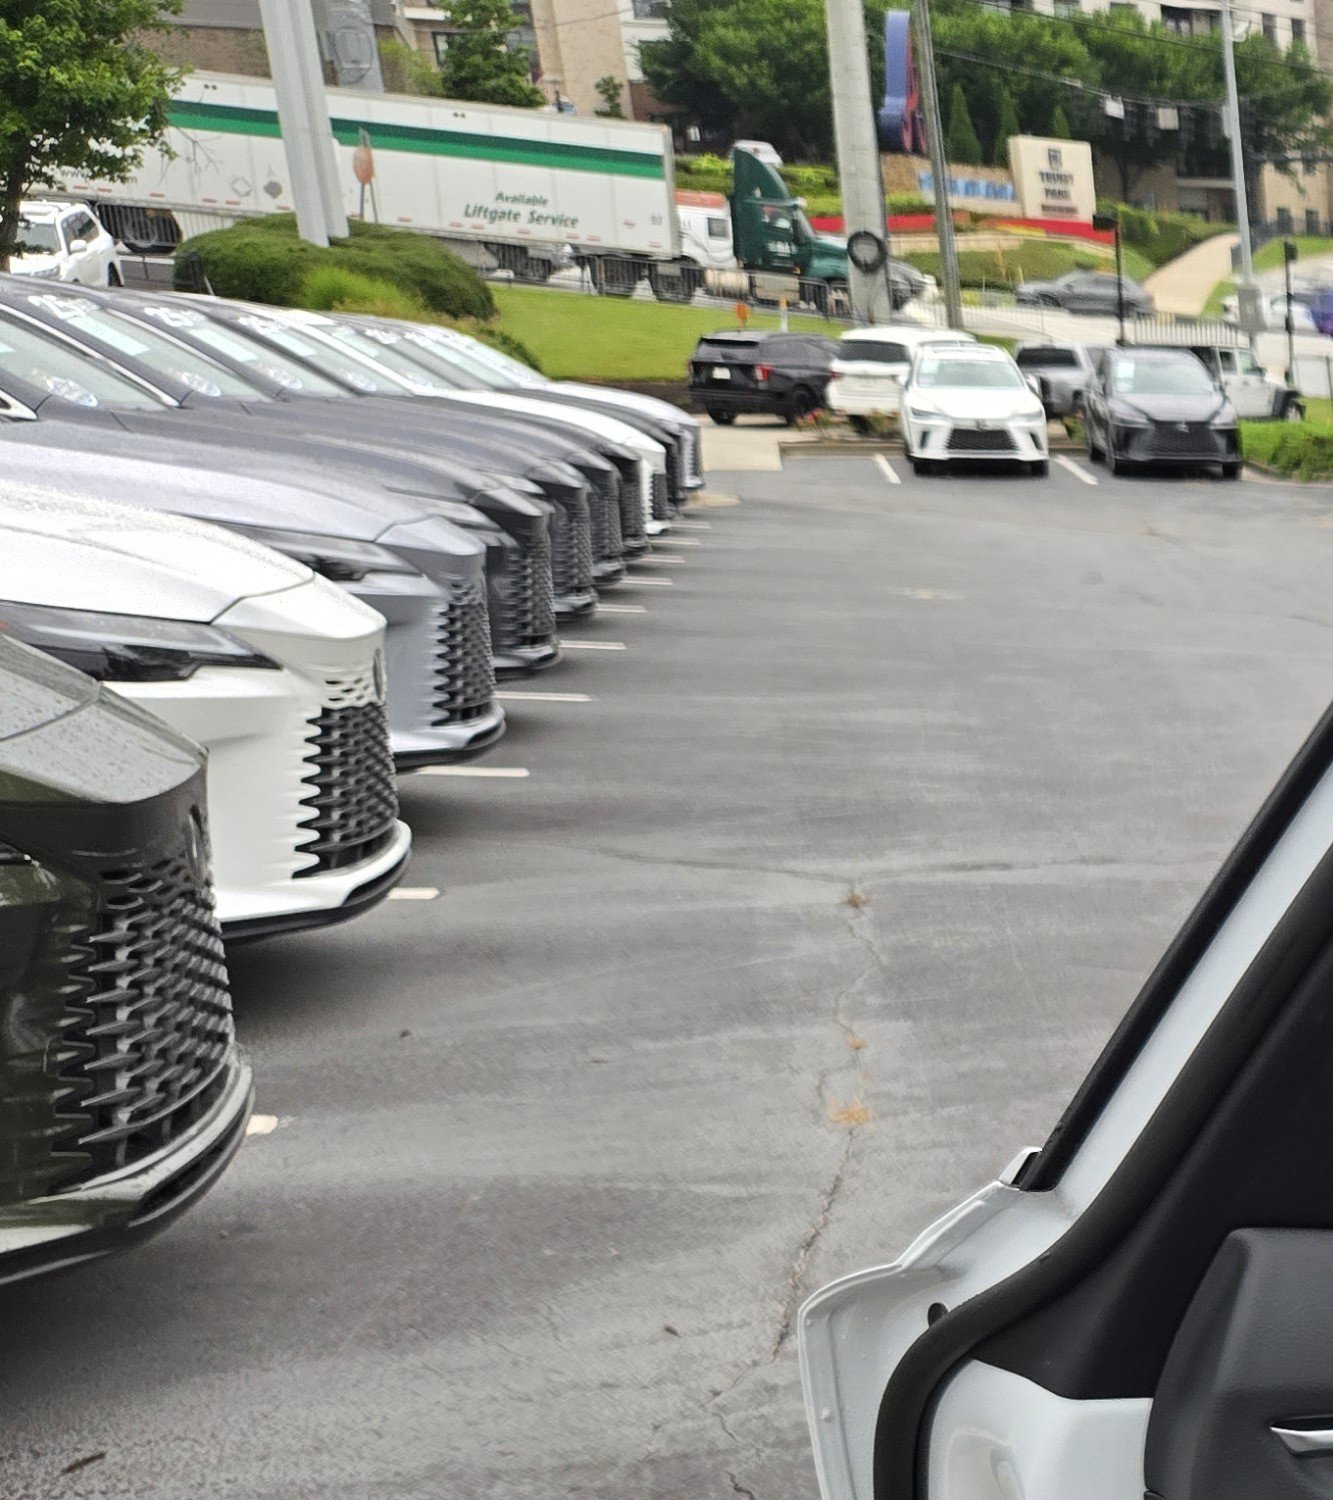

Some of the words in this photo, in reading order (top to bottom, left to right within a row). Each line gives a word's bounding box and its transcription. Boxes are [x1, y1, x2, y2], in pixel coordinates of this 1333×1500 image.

[495, 191, 549, 206] Available
[464, 204, 521, 223] Liftgate
[527, 210, 579, 228] Service
